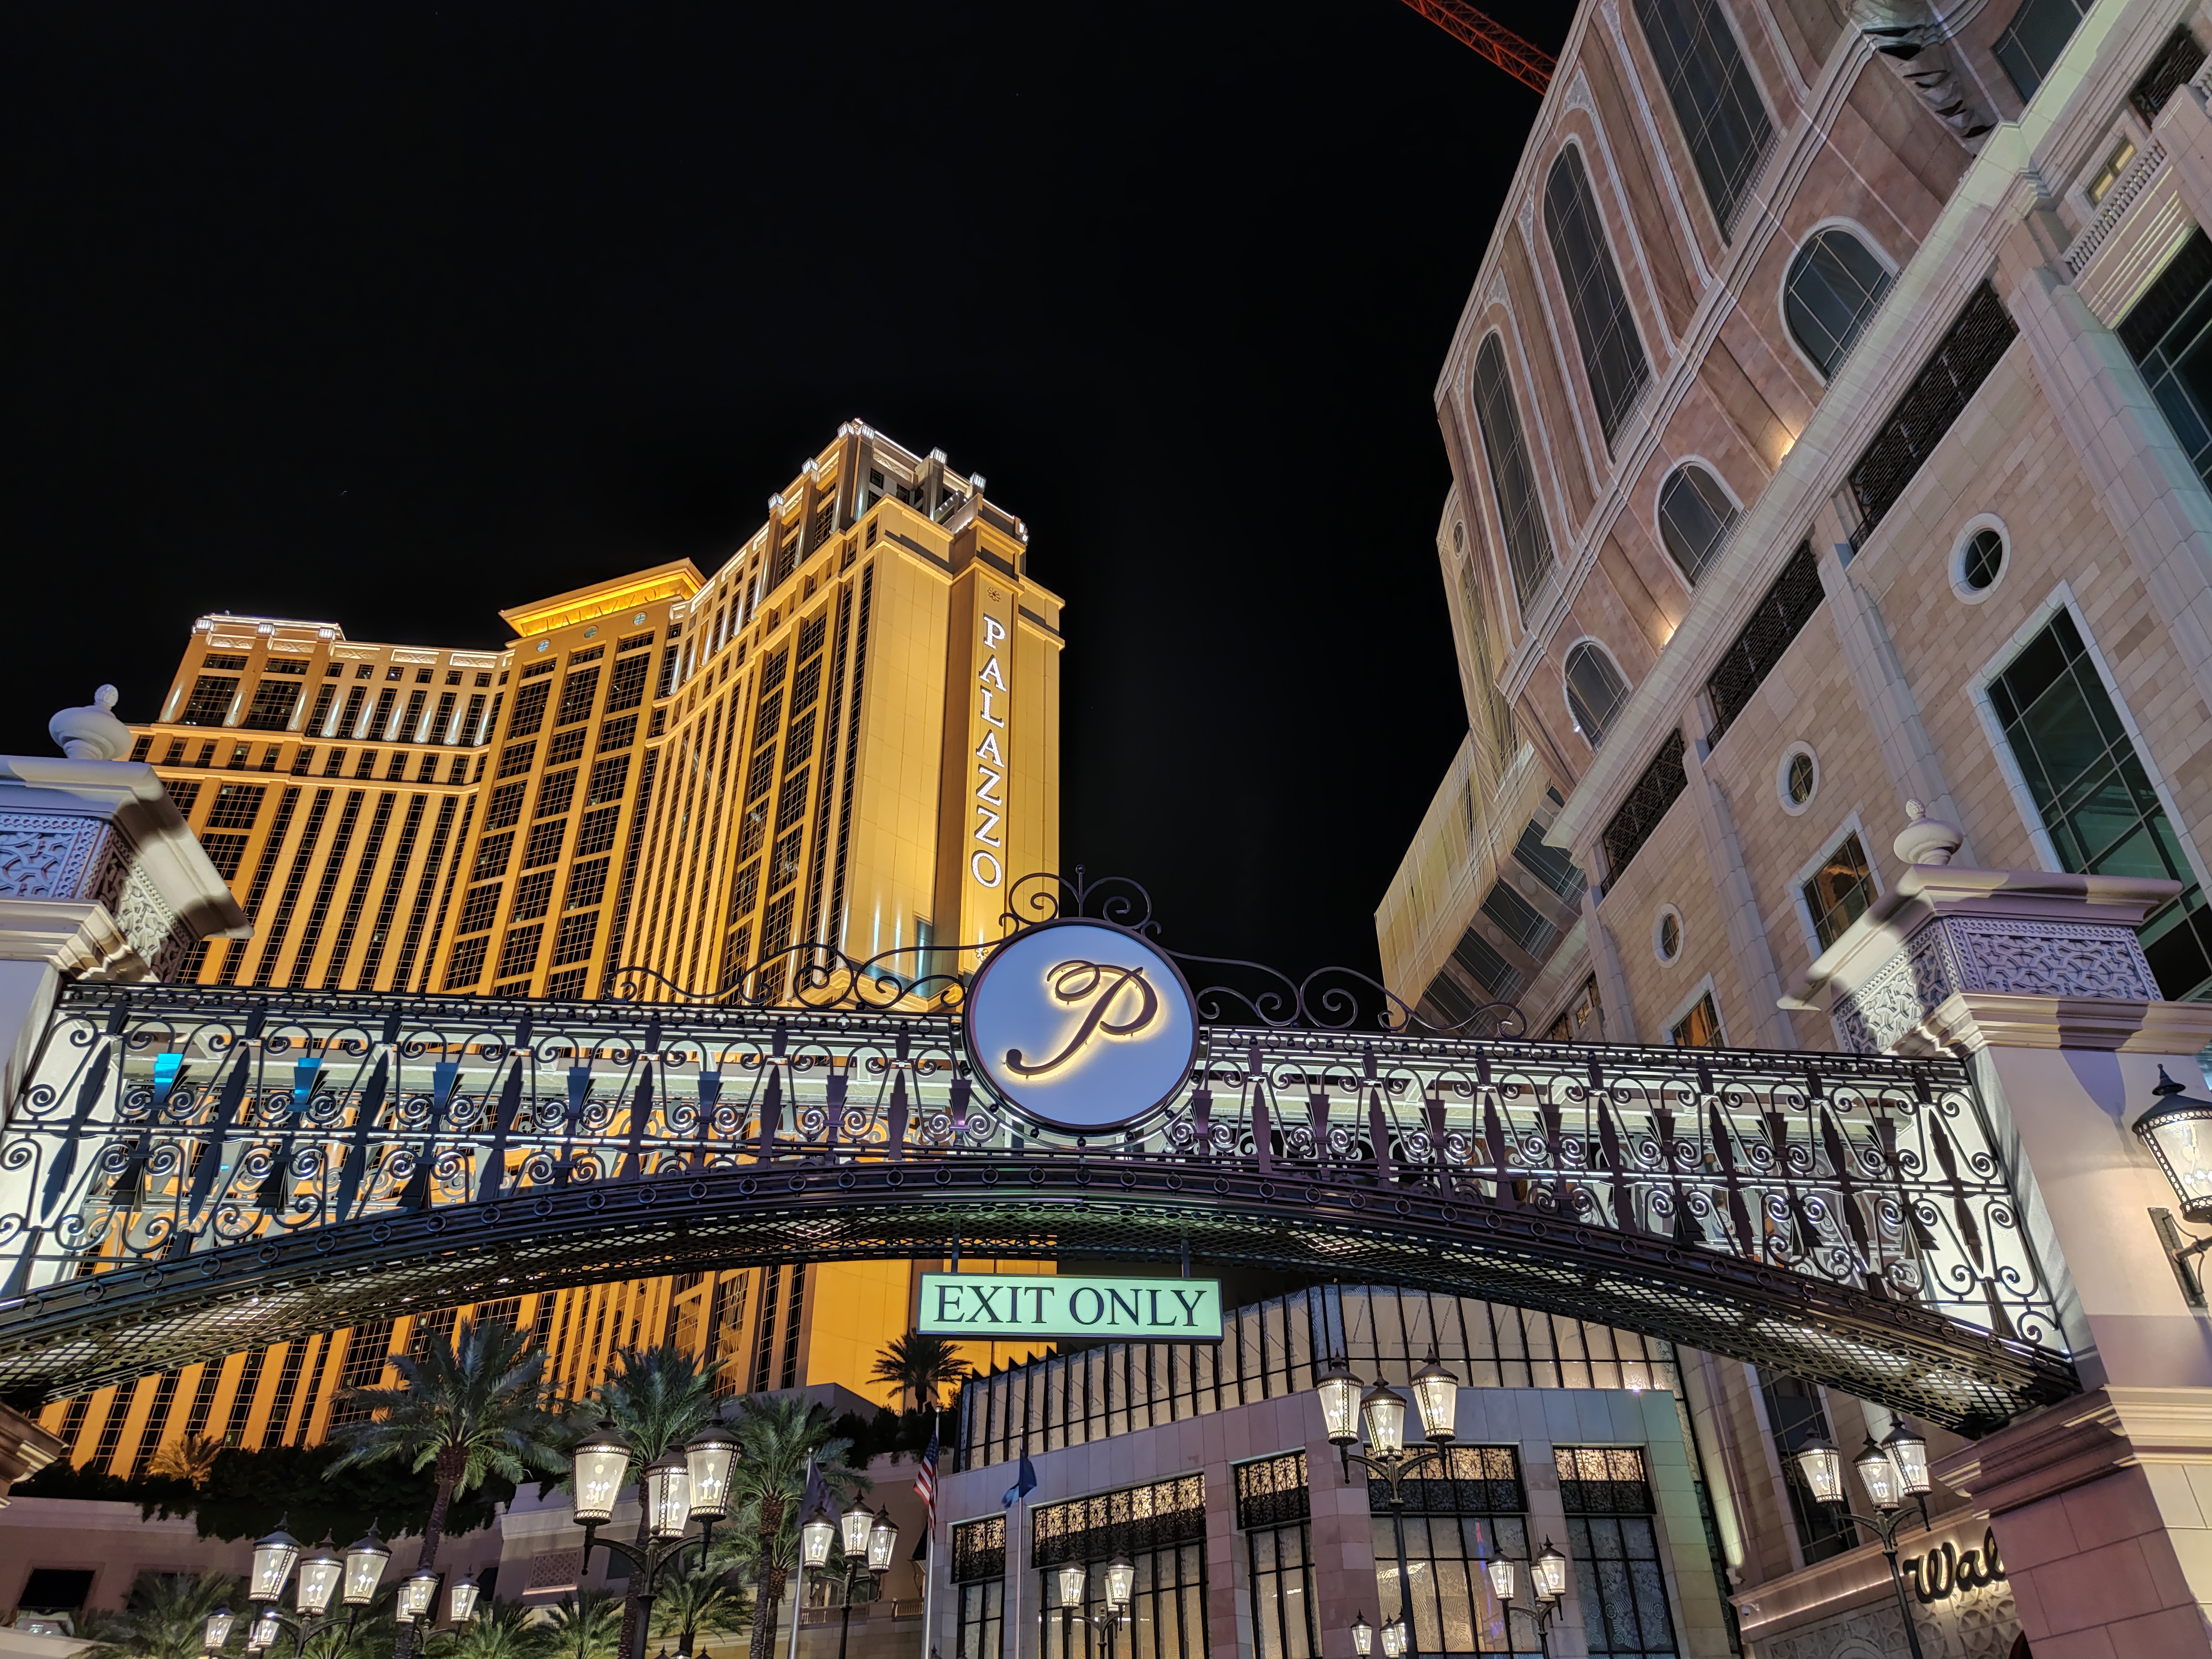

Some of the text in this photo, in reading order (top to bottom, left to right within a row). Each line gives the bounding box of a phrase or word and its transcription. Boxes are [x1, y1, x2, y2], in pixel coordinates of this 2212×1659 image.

[972, 614, 1007, 888] PALAZZO
[933, 1285, 1207, 1327] EXIT ONLY
